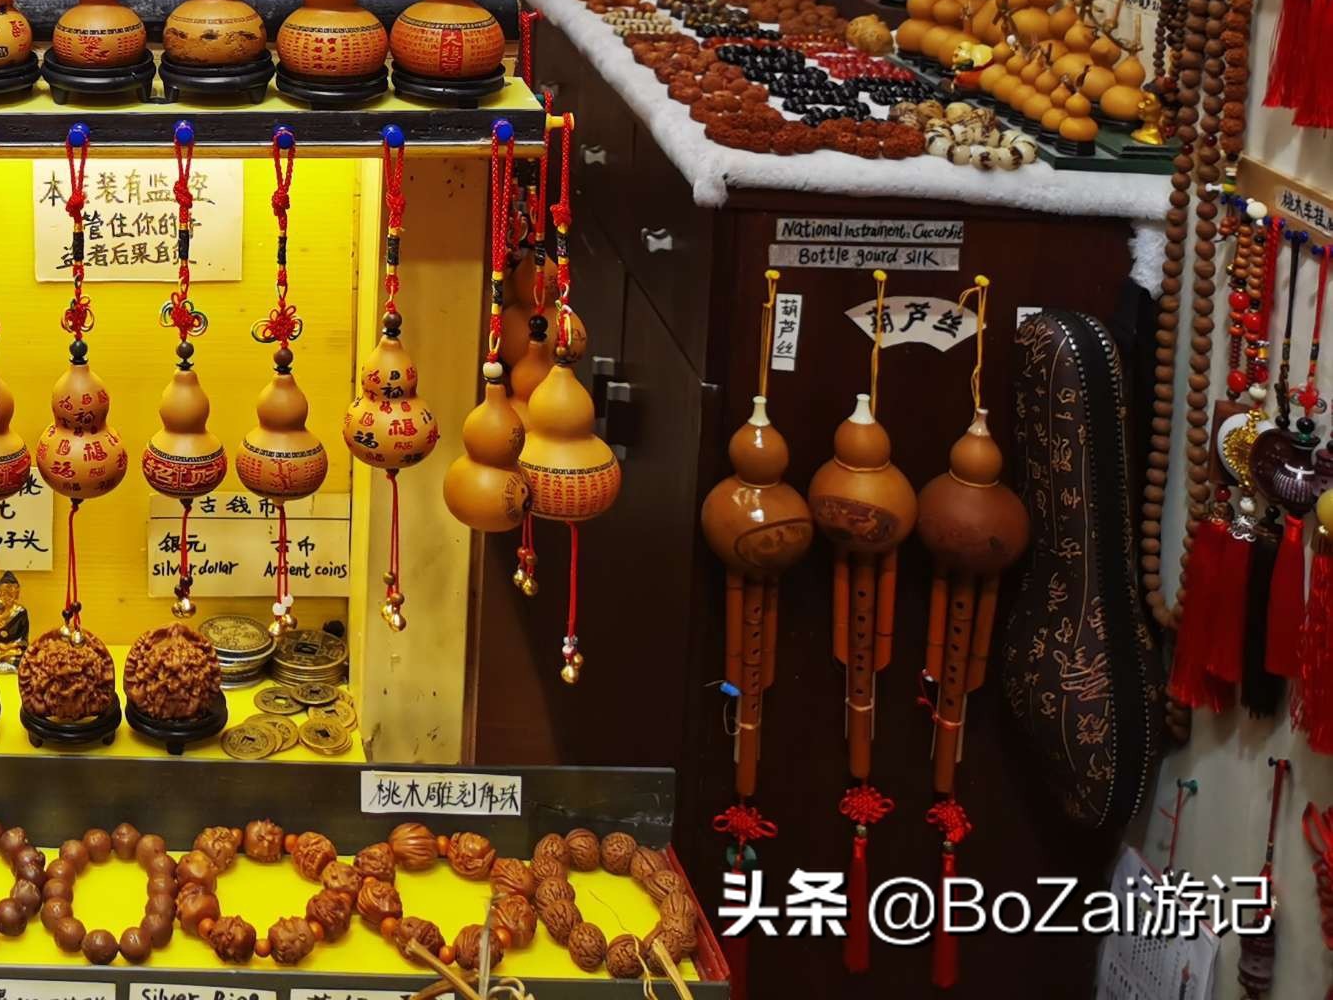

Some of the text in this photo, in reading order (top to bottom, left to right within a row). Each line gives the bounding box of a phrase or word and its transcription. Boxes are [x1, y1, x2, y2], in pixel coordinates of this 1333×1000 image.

[40, 169, 216, 207] 本装有监控
[781, 220, 842, 238] National
[798, 247, 849, 264] Bottle
[857, 251, 898, 267] gourd
[774, 299, 798, 359] 葫芦丝
[865, 302, 963, 339] 葫芦丝
[387, 418, 418, 437] 福
[84, 441, 108, 462] 福
[199, 496, 276, 517] 古钱币
[153, 562, 196, 577] silvr
[198, 559, 239, 577] dollar
[315, 562, 347, 579] coins
